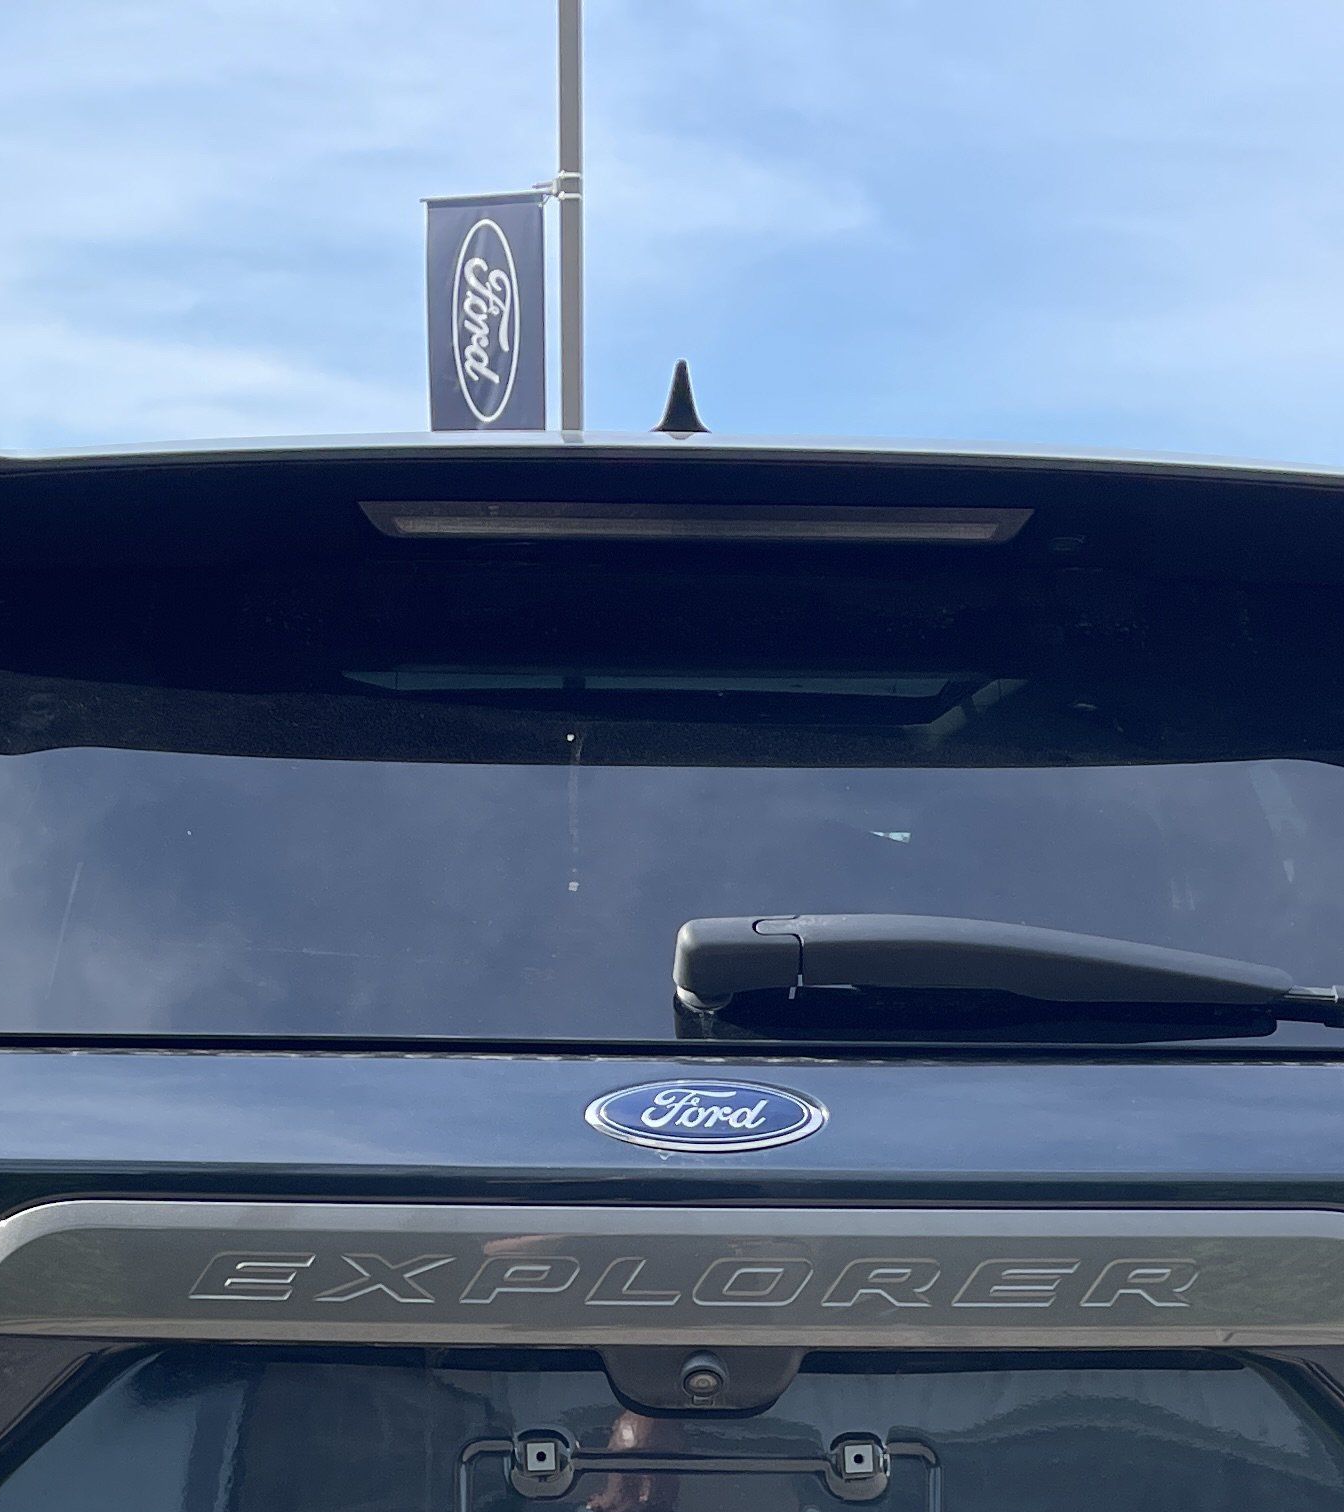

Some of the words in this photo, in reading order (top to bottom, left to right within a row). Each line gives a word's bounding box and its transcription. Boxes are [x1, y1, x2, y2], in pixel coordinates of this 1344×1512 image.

[463, 257, 511, 384] Ford
[641, 1088, 767, 1129] Ford
[188, 1251, 1200, 1307] EXPLORER
